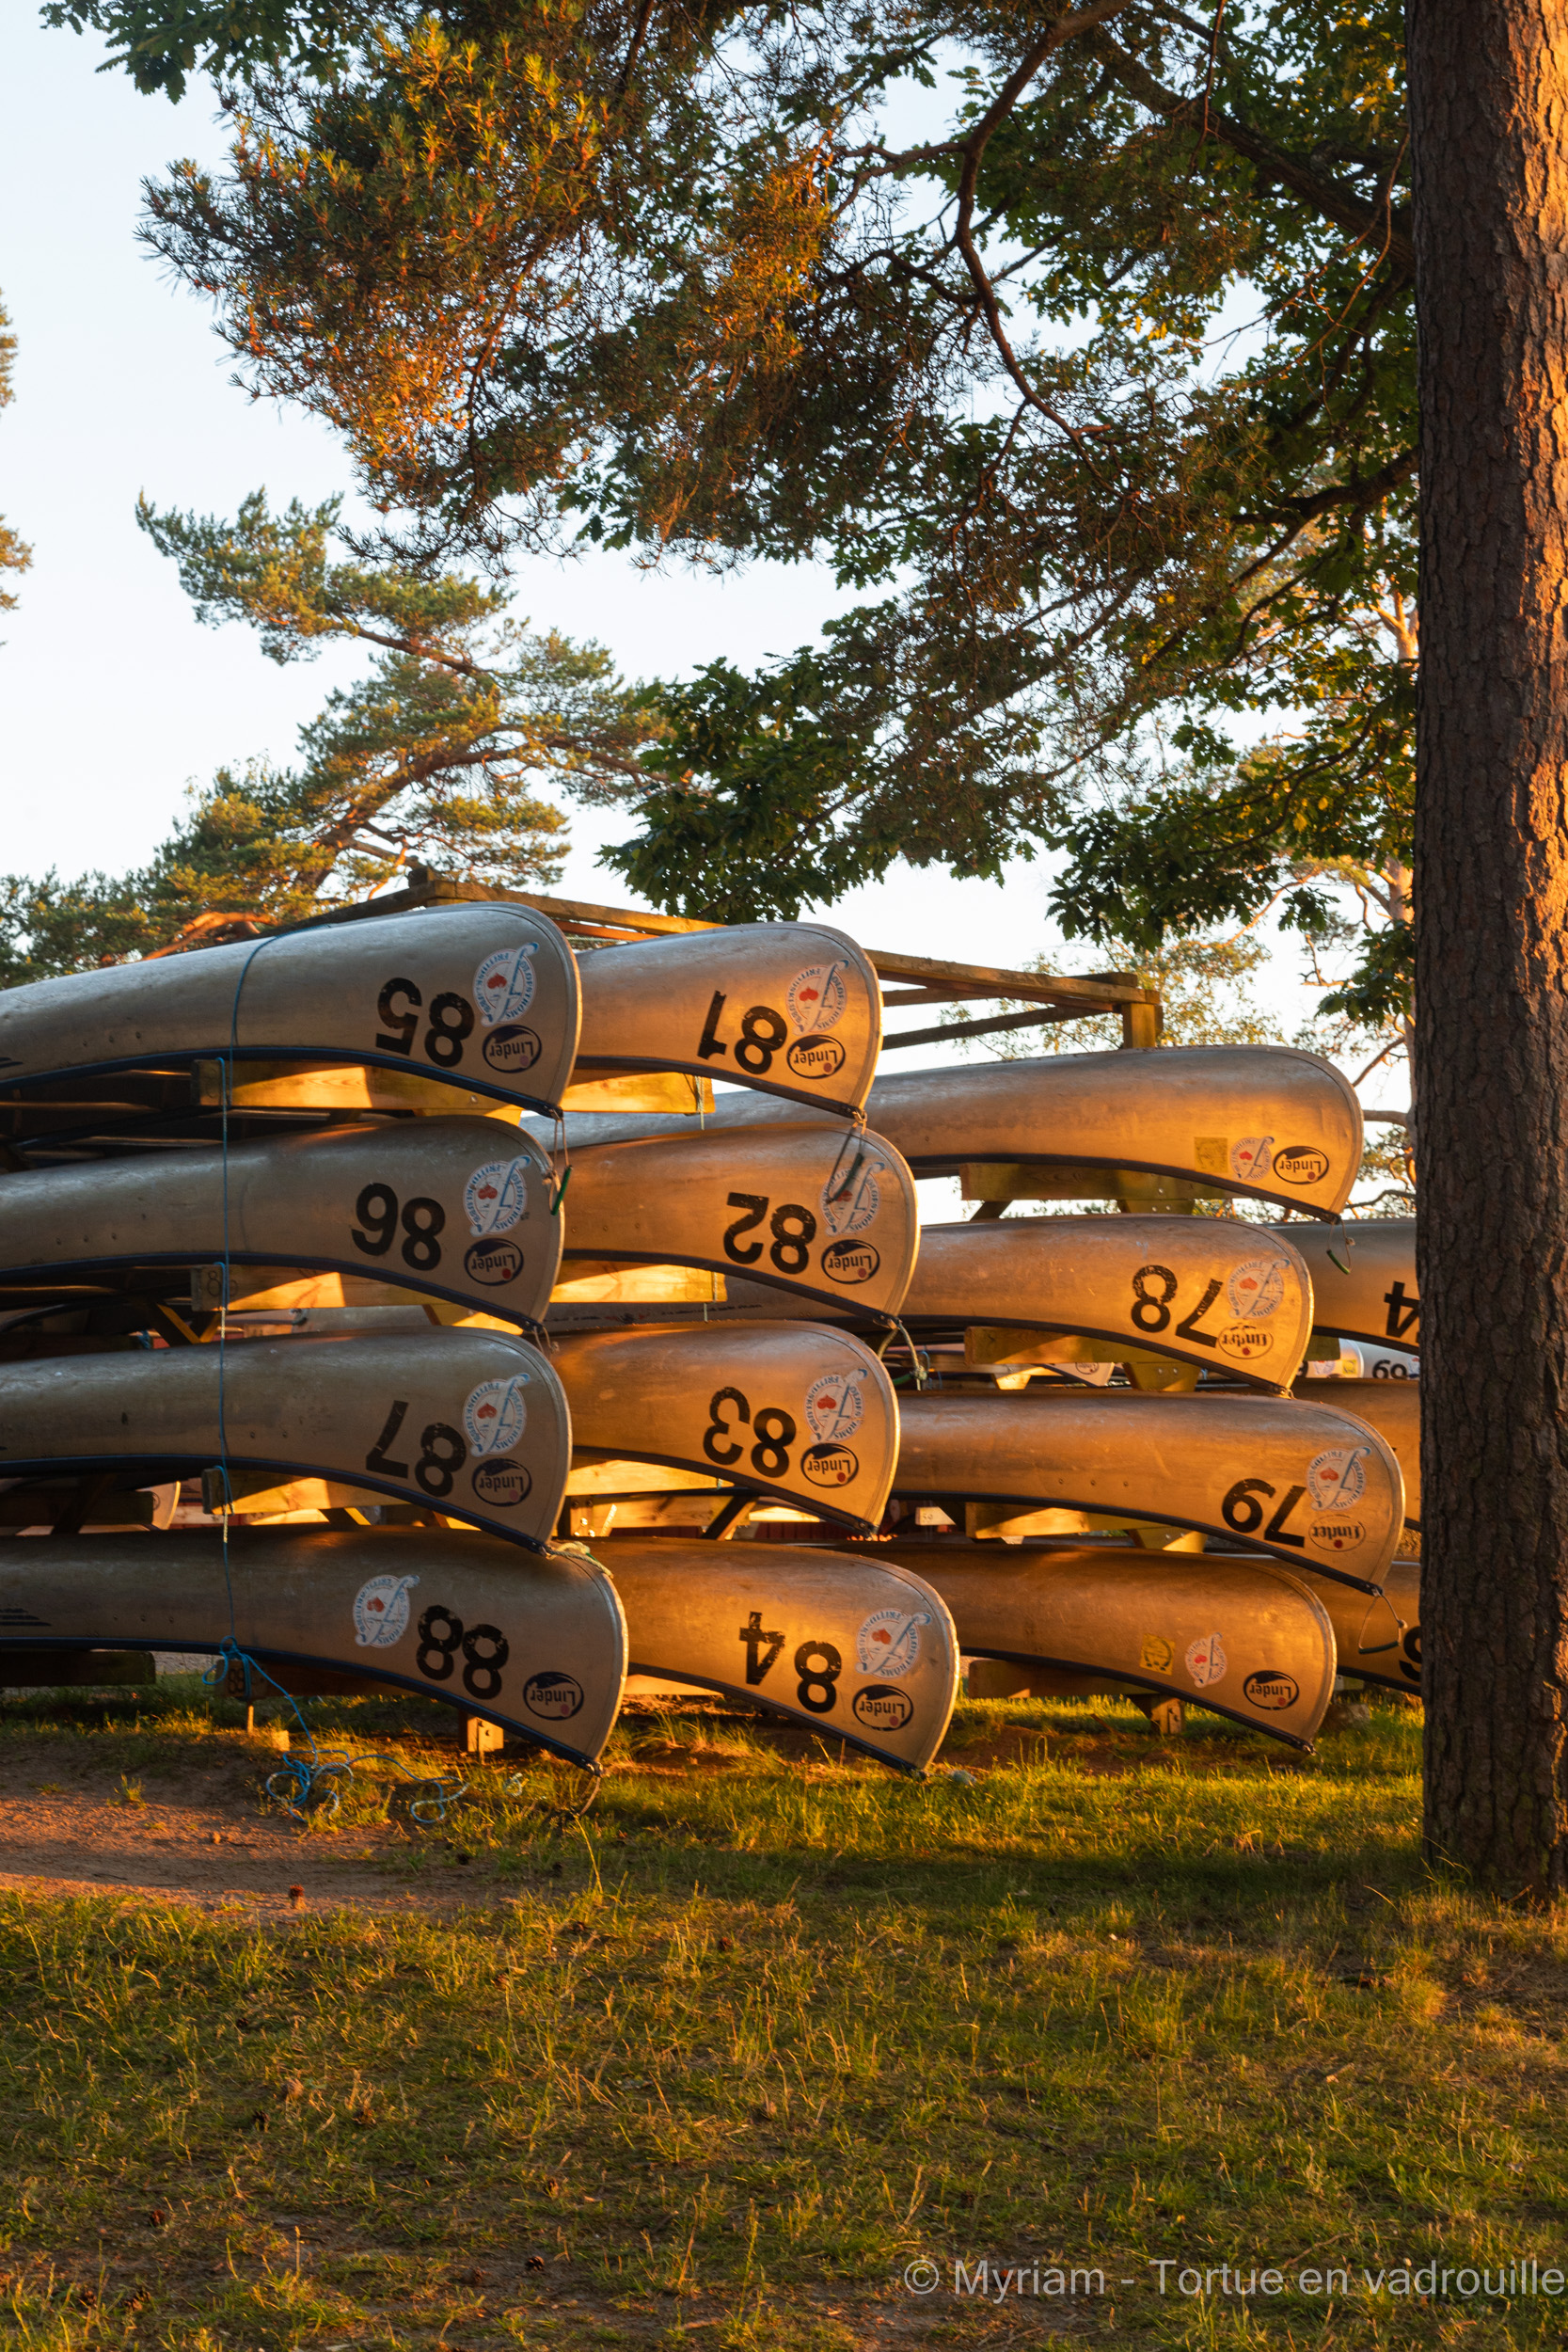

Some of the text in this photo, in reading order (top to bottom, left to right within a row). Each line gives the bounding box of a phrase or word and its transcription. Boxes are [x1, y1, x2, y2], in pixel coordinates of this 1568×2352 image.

[505, 959, 532, 1019] OLOFSTRÖMS
[816, 974, 845, 1029] OLOFSTRÖMS
[375, 977, 475, 1068] 85
[489, 1041, 533, 1059] Linder
[697, 990, 787, 1074] 81
[794, 1049, 837, 1066] Linder
[1279, 1158, 1321, 1172] Linder
[464, 1163, 501, 1224] FRITIDKLUBB
[496, 1172, 525, 1231] OLOFSTRÖMS
[351, 1183, 446, 1271] 86
[723, 1192, 816, 1274] 82
[471, 1252, 515, 1271] Linder
[829, 1251, 872, 1270] Linder
[1132, 1264, 1223, 1347] 78
[1384, 1280, 1419, 1339] 4
[1222, 1333, 1267, 1347] Linder
[366, 1401, 466, 1496] 87
[704, 1387, 796, 1477] 83
[479, 1473, 524, 1491] Linder
[808, 1459, 850, 1474] Linder
[1334, 1460, 1364, 1508] OLOFSTRÖMS
[1222, 1478, 1306, 1549] 79
[1313, 1525, 1360, 1539] Linder
[417, 1605, 509, 1699] 88
[739, 1612, 842, 1713] 84
[879, 1627, 918, 1676] OLOFSTRÖMS
[531, 1690, 575, 1704] Linder
[860, 1700, 905, 1717] Linder
[1250, 1685, 1291, 1699] Linder
